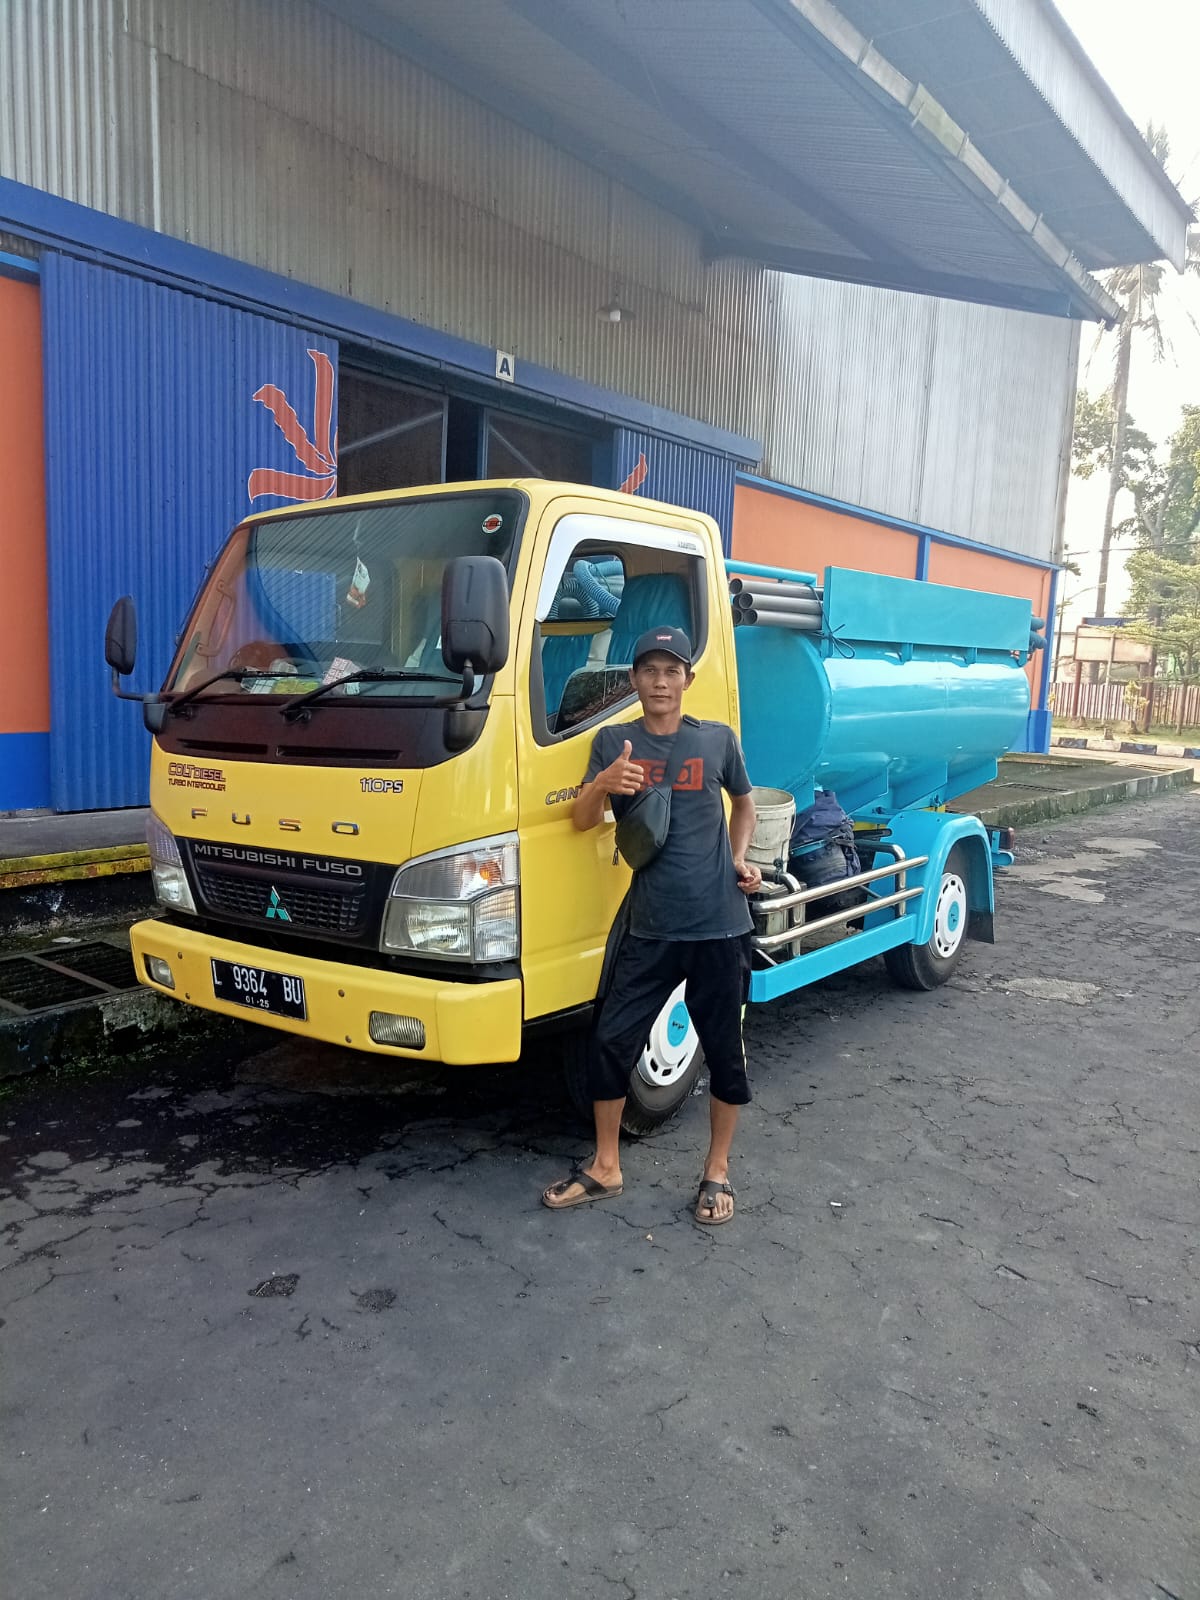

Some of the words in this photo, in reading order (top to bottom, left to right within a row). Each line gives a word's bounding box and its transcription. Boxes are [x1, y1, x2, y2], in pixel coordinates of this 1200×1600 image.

[499, 357, 511, 377] A
[168, 778, 186, 787] TURBO
[187, 780, 226, 792] INTERCOOLER
[360, 777, 404, 794] 110PS
[191, 807, 360, 836] FUSO
[194, 844, 296, 868] MITSUBISHI
[302, 858, 363, 876] FUSO
[212, 960, 222, 985] L
[232, 965, 268, 996] 9364
[282, 976, 302, 1004] BU
